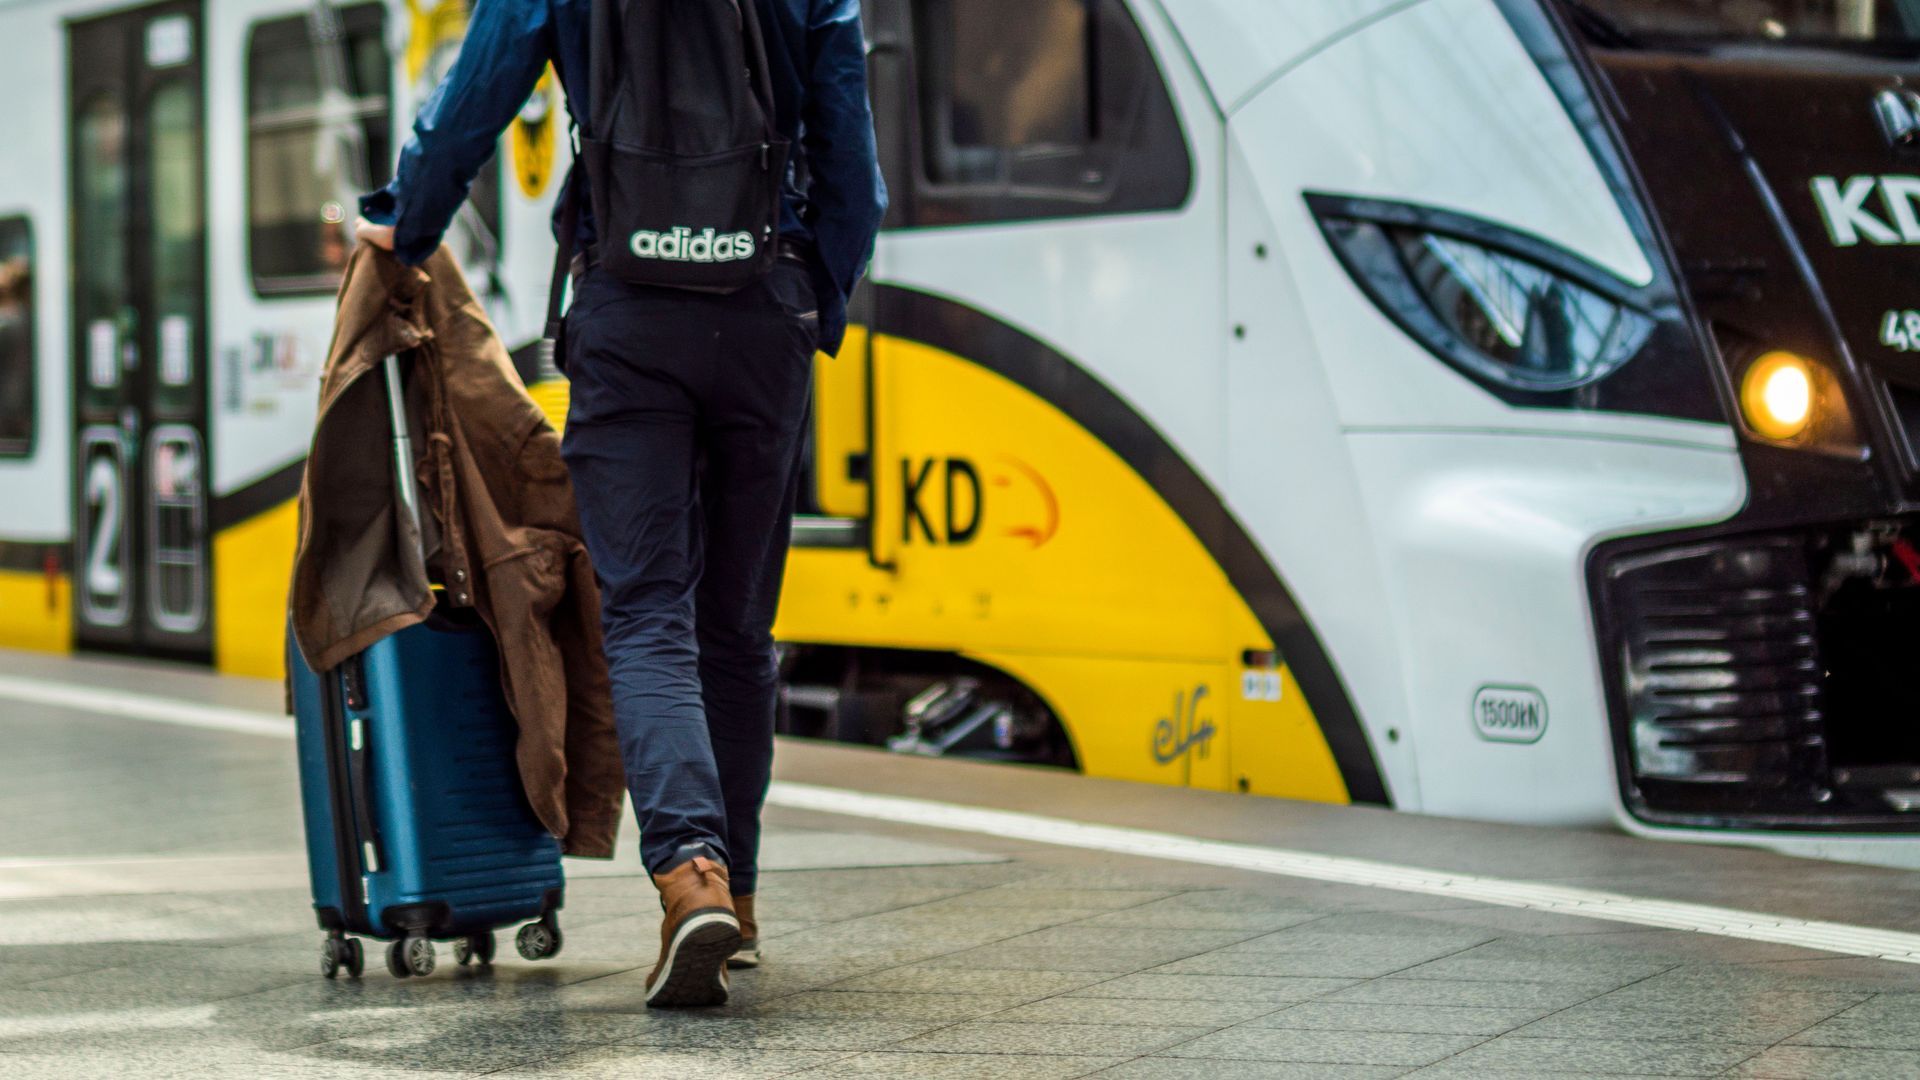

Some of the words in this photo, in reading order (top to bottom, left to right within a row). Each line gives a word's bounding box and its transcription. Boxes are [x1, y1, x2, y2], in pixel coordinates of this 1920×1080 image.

[630, 226, 755, 262] adidas
[88, 457, 121, 596] 2
[899, 457, 984, 546] KD
[1481, 699, 1540, 730] 1500kN
